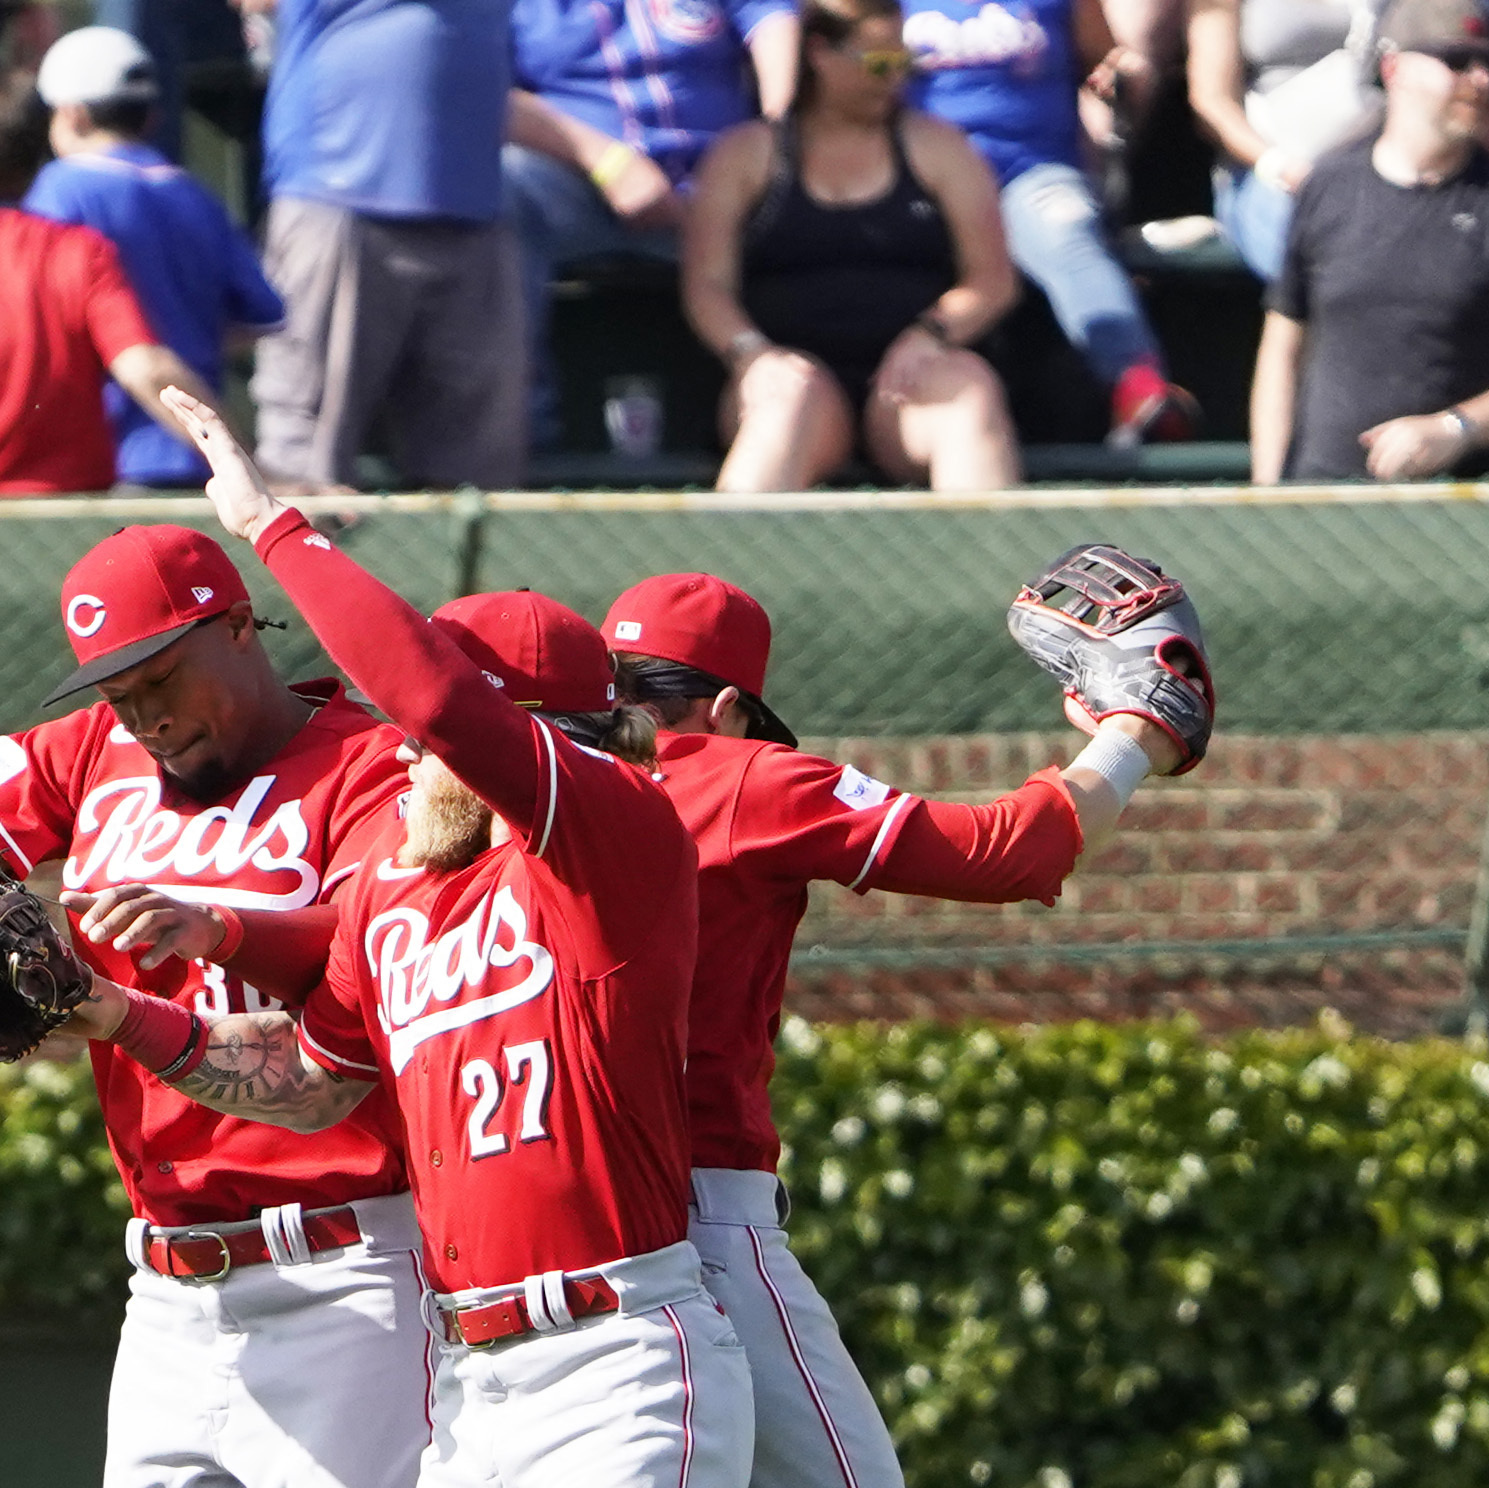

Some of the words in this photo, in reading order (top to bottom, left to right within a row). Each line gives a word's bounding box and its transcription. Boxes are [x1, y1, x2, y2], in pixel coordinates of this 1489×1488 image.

[67, 594, 107, 638] C
[63, 774, 312, 891] Reds
[365, 885, 553, 1034] Reds
[461, 1038, 554, 1162] 27
